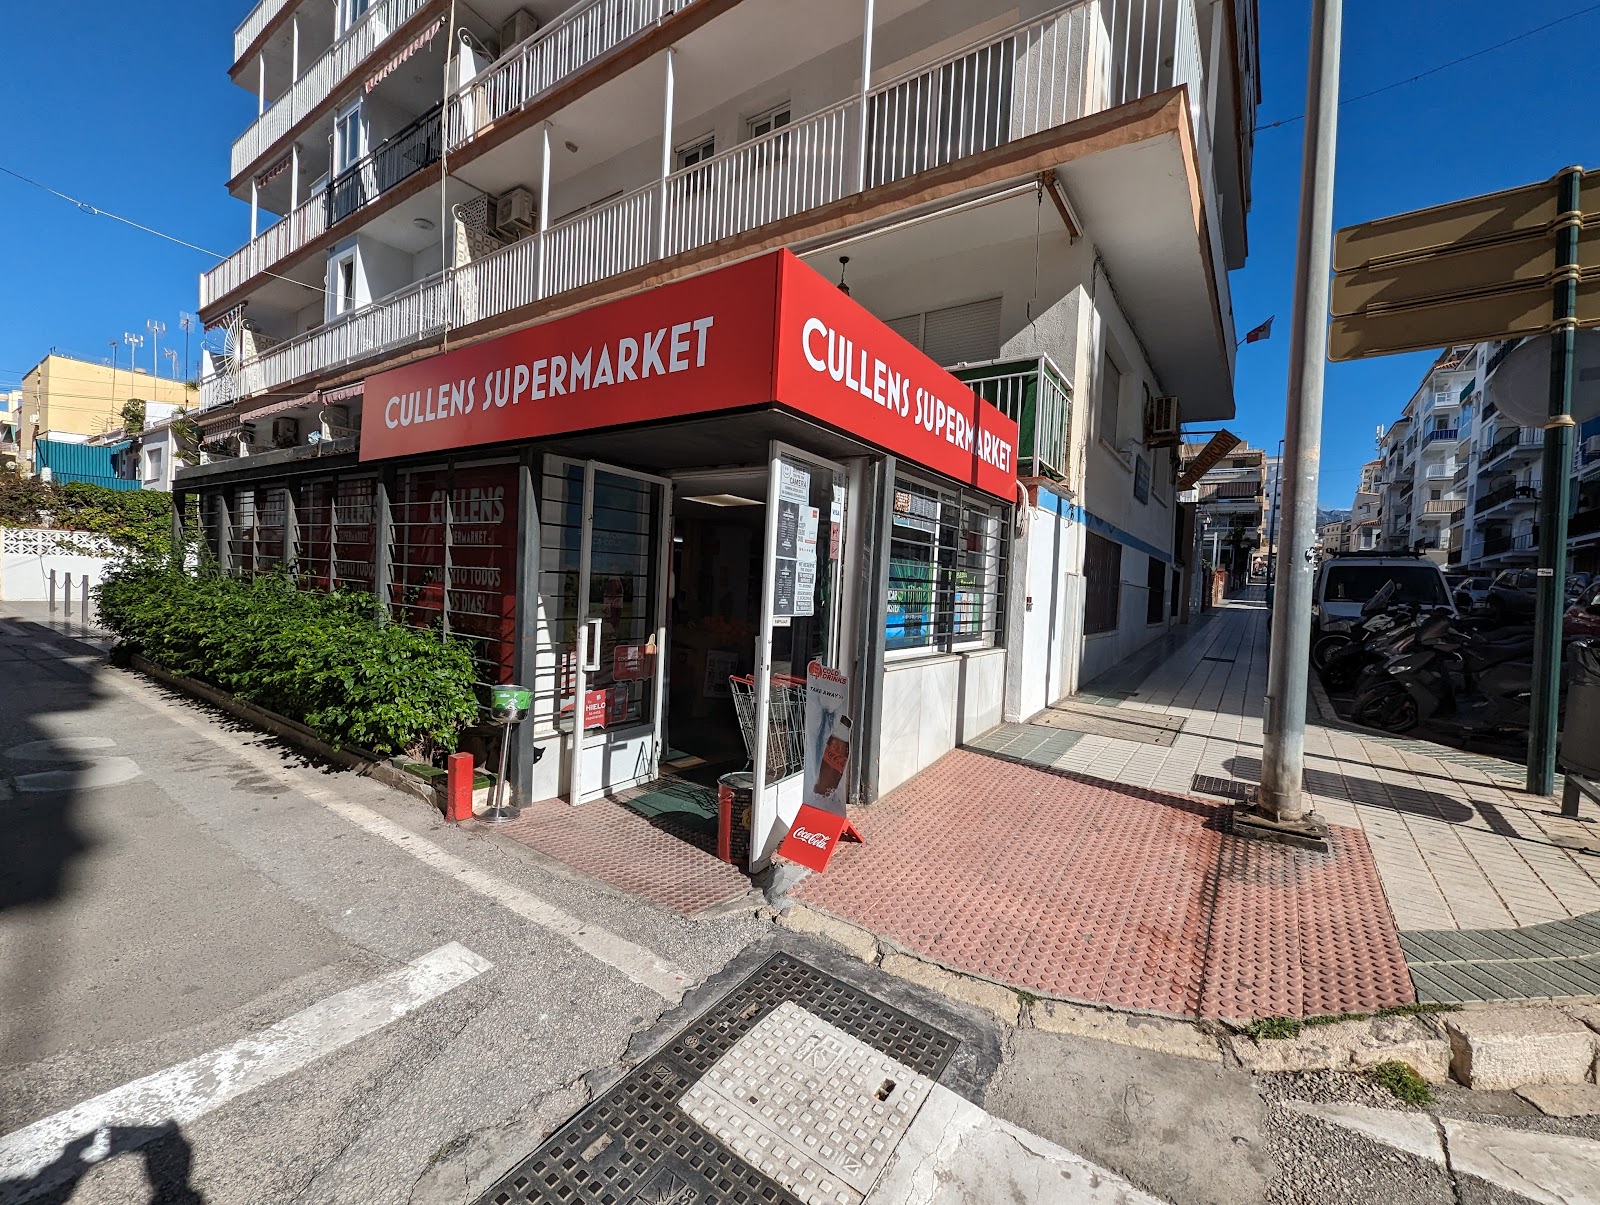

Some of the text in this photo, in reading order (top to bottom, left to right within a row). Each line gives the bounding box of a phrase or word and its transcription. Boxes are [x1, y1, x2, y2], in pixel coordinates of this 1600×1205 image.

[385, 316, 715, 430] CULLENS SUPERMARKET
[802, 317, 1013, 474] CULLENS SUPERMARKET
[790, 477, 807, 489] CAMERA
[832, 508, 840, 516] VISA
[443, 530, 488, 544] SPERMARKET
[433, 567, 501, 586] ABRTO TODOS
[822, 668, 839, 677] COLD
[822, 674, 847, 685] DRINKS
[810, 686, 839, 699] TAKE AWAY
[585, 702, 606, 711] HIELO
